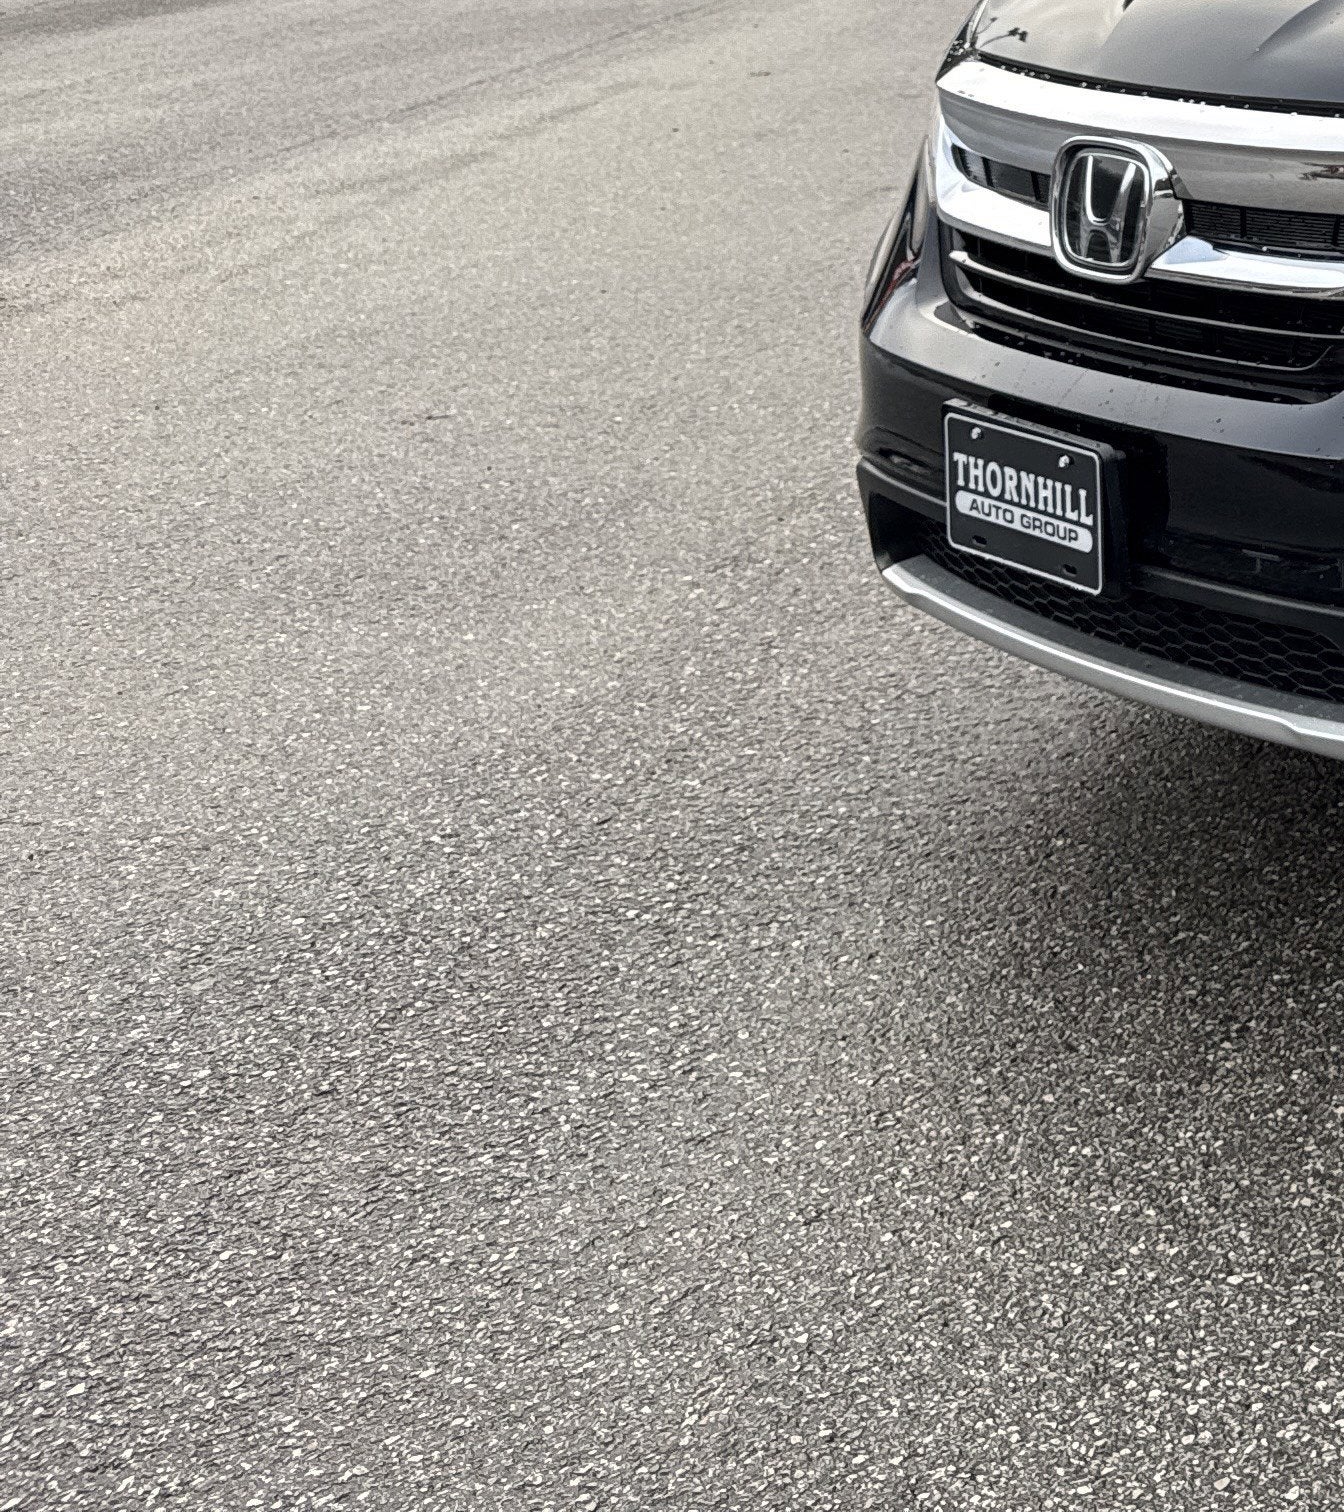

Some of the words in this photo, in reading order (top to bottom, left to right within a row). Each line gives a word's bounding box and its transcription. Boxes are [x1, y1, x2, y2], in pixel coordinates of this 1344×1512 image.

[953, 451, 1093, 526] THORNHILL
[969, 498, 1015, 524] AUTO
[1020, 513, 1079, 543] GROUP
